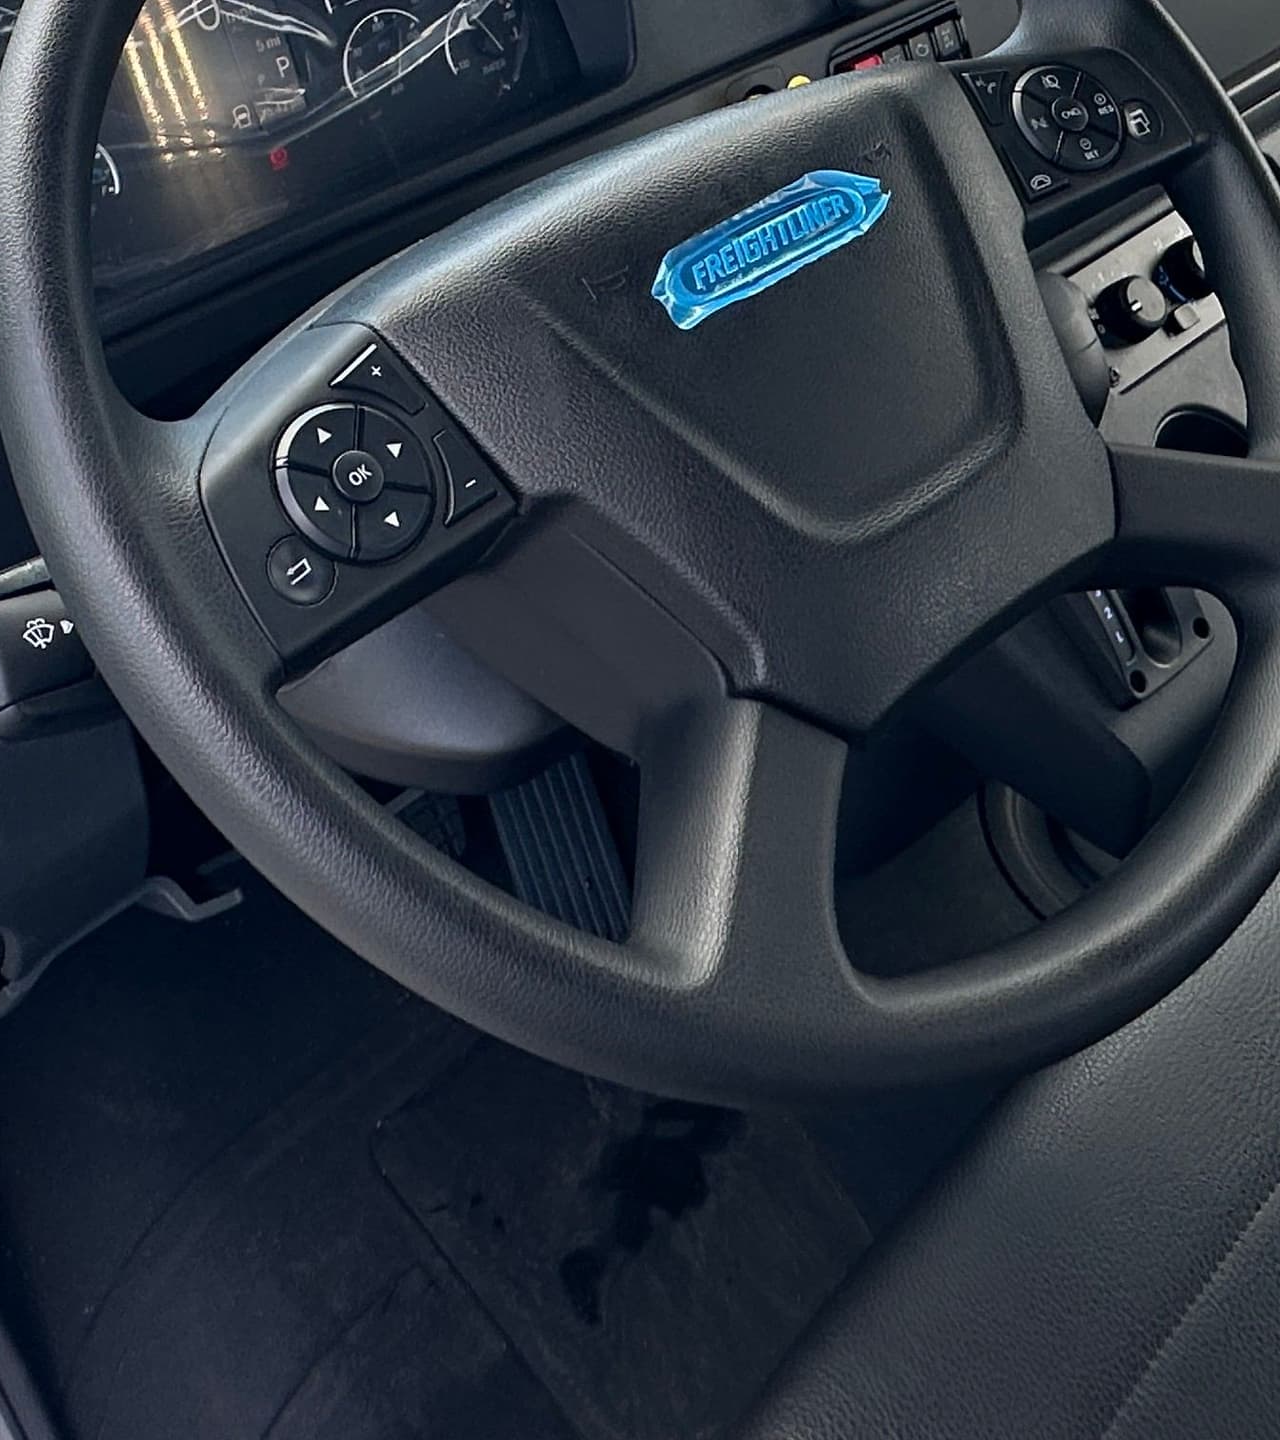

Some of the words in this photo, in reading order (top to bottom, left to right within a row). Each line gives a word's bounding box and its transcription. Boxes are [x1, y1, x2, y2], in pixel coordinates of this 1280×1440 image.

[276, 55, 290, 79] P
[690, 193, 850, 291] FREIGHTLINER
[348, 463, 373, 486] OK
